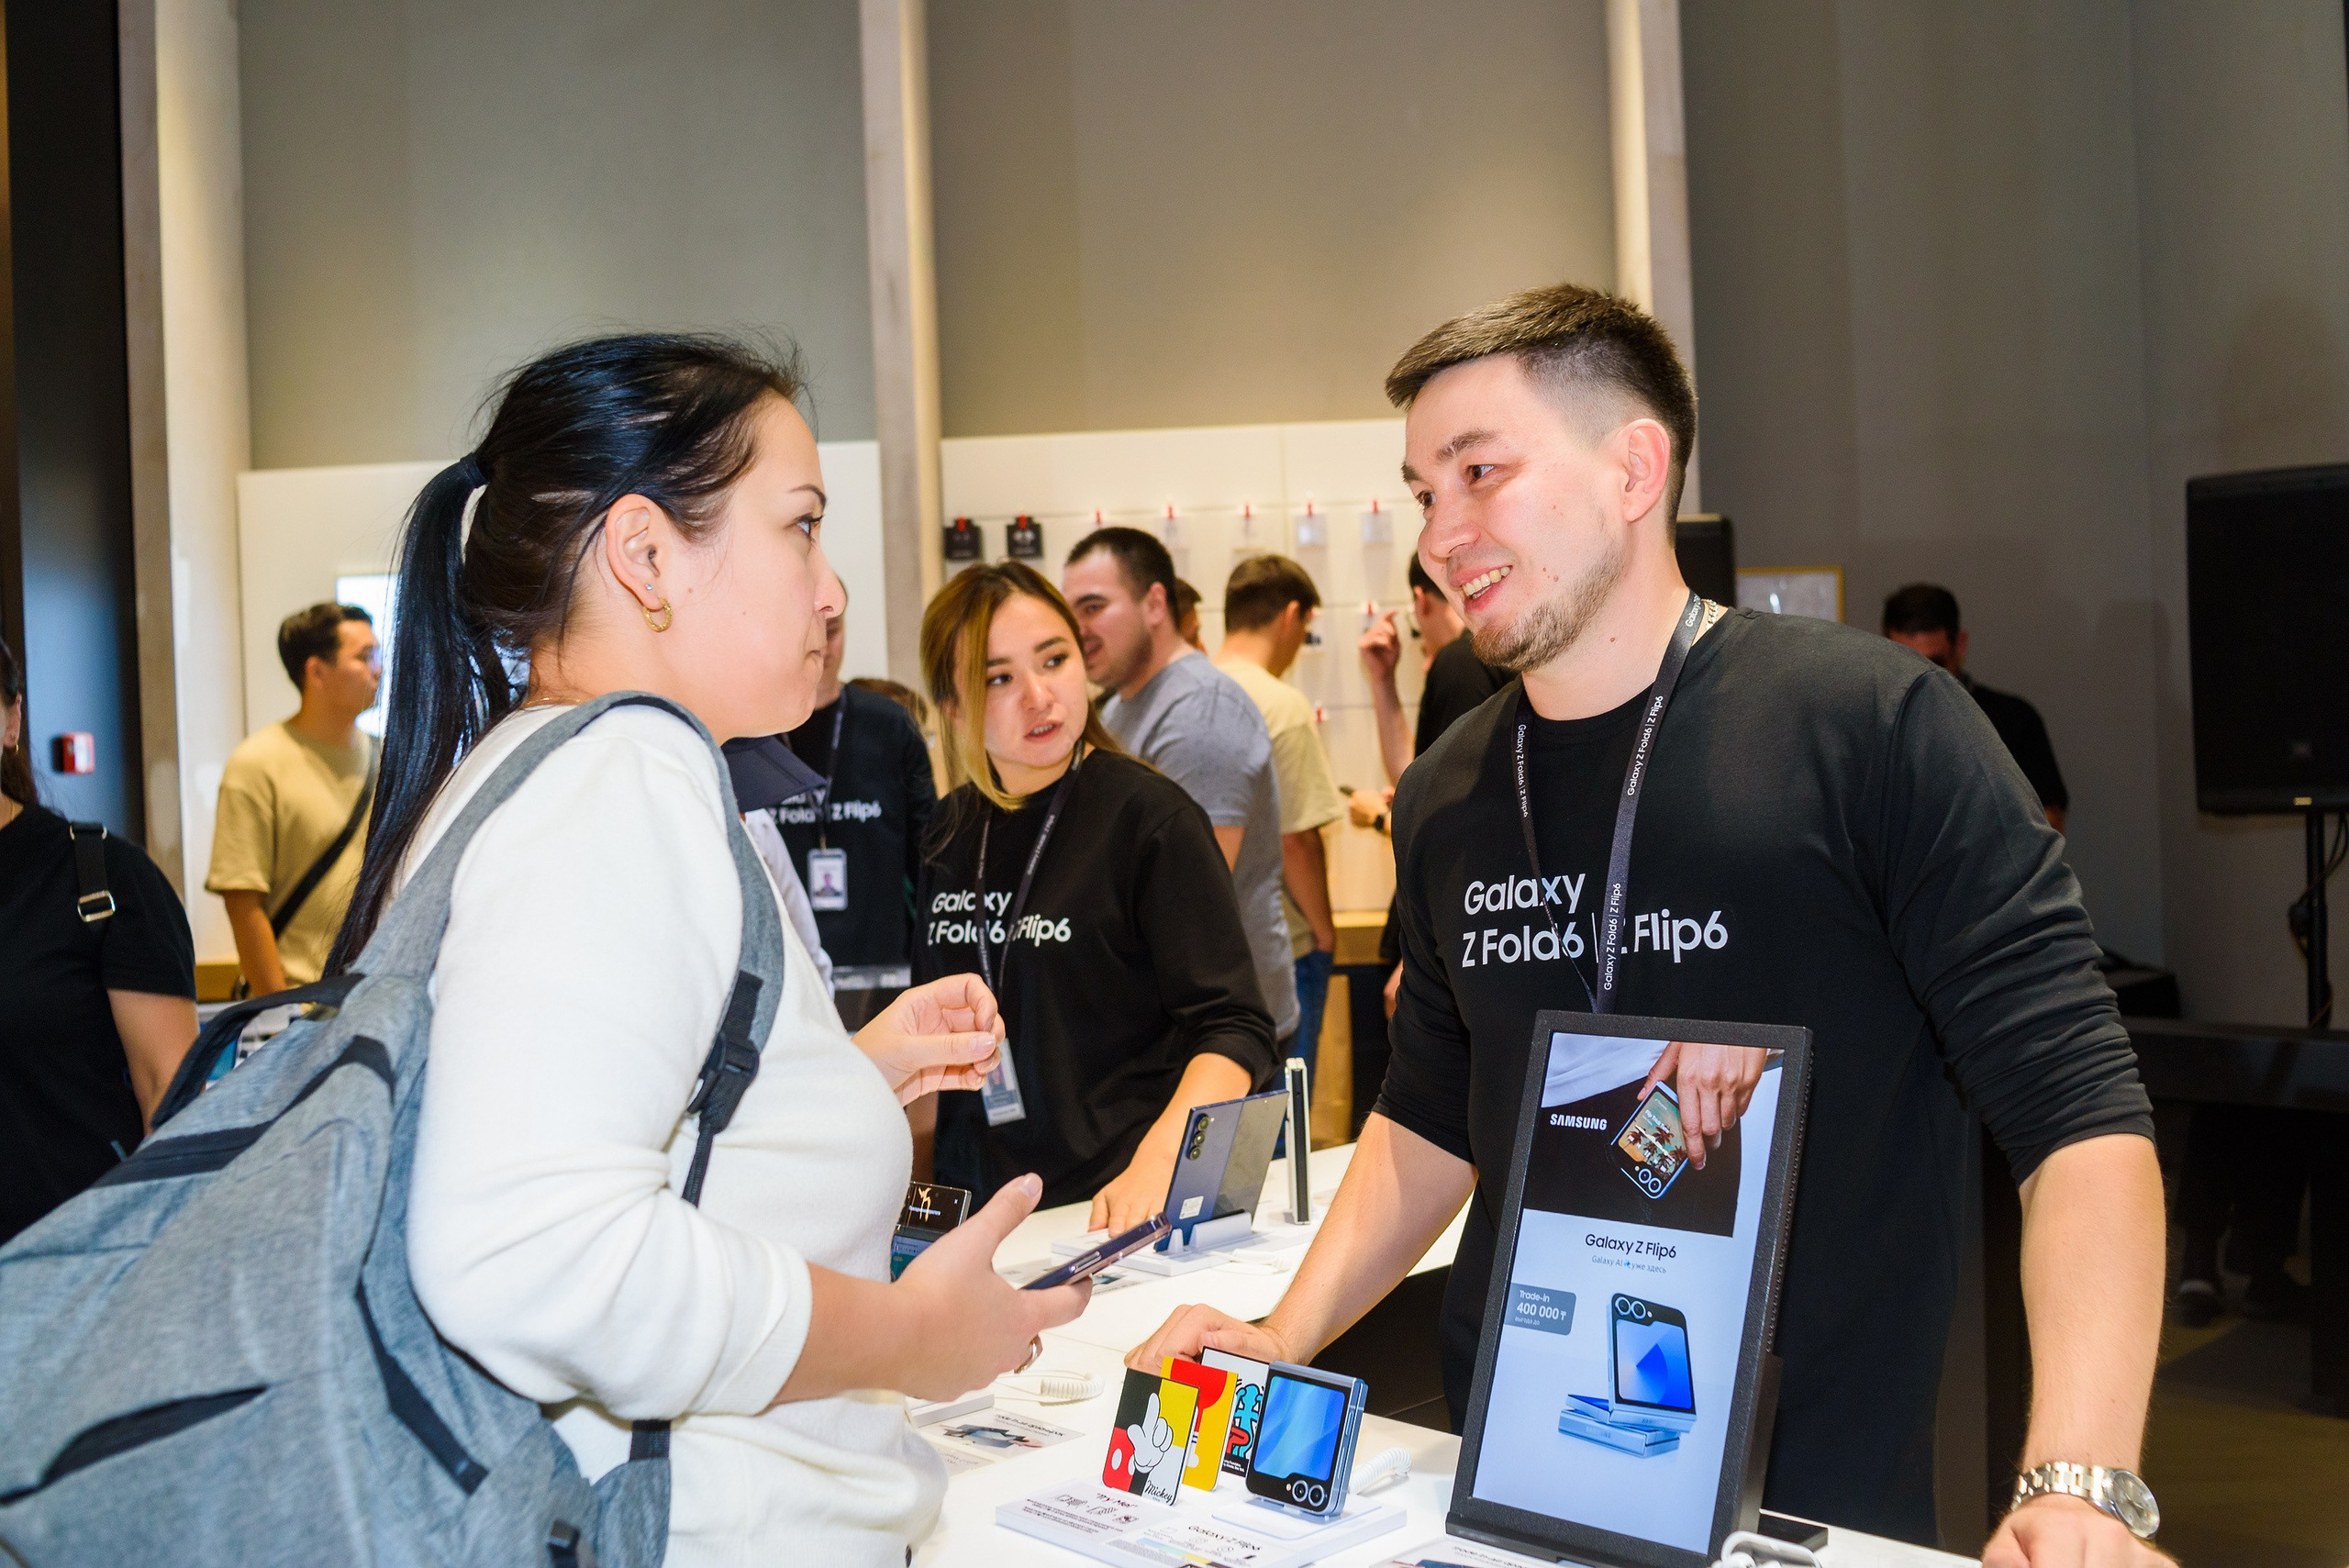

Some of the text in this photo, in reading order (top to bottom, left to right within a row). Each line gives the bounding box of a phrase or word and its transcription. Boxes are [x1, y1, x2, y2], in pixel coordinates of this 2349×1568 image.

[1515, 724, 1527, 753] Galaxy
[1627, 760, 1644, 795] Galaxy
[1637, 728, 1653, 752] Fold6
[1649, 695, 1664, 717] Flip6
[1517, 760, 1525, 785] Fold6
[778, 806, 817, 825] Fold
[843, 800, 883, 823] Flip6
[1520, 795, 1529, 817] Flip6
[1464, 873, 1586, 916] Galaxy
[1610, 883, 1623, 906] Flip6
[1017, 913, 1072, 948] Flip6
[1462, 931, 1476, 968] Z
[1482, 921, 1585, 965] Fold6
[1633, 908, 1729, 963] Flip6
[1606, 918, 1618, 946] Fold6
[1603, 954, 1617, 991] Galaxy
[1550, 1113, 1608, 1130] SAMSUNG
[1585, 1233, 1676, 1262] Galaxy Z Flip6
[1591, 1255, 1667, 1274] Galaxy AI уже здесь
[1519, 1290, 1551, 1303] Trade-in
[1516, 1302, 1537, 1316] 400
[1539, 1306, 1560, 1320] 000
[1144, 1479, 1173, 1504] Mickey
